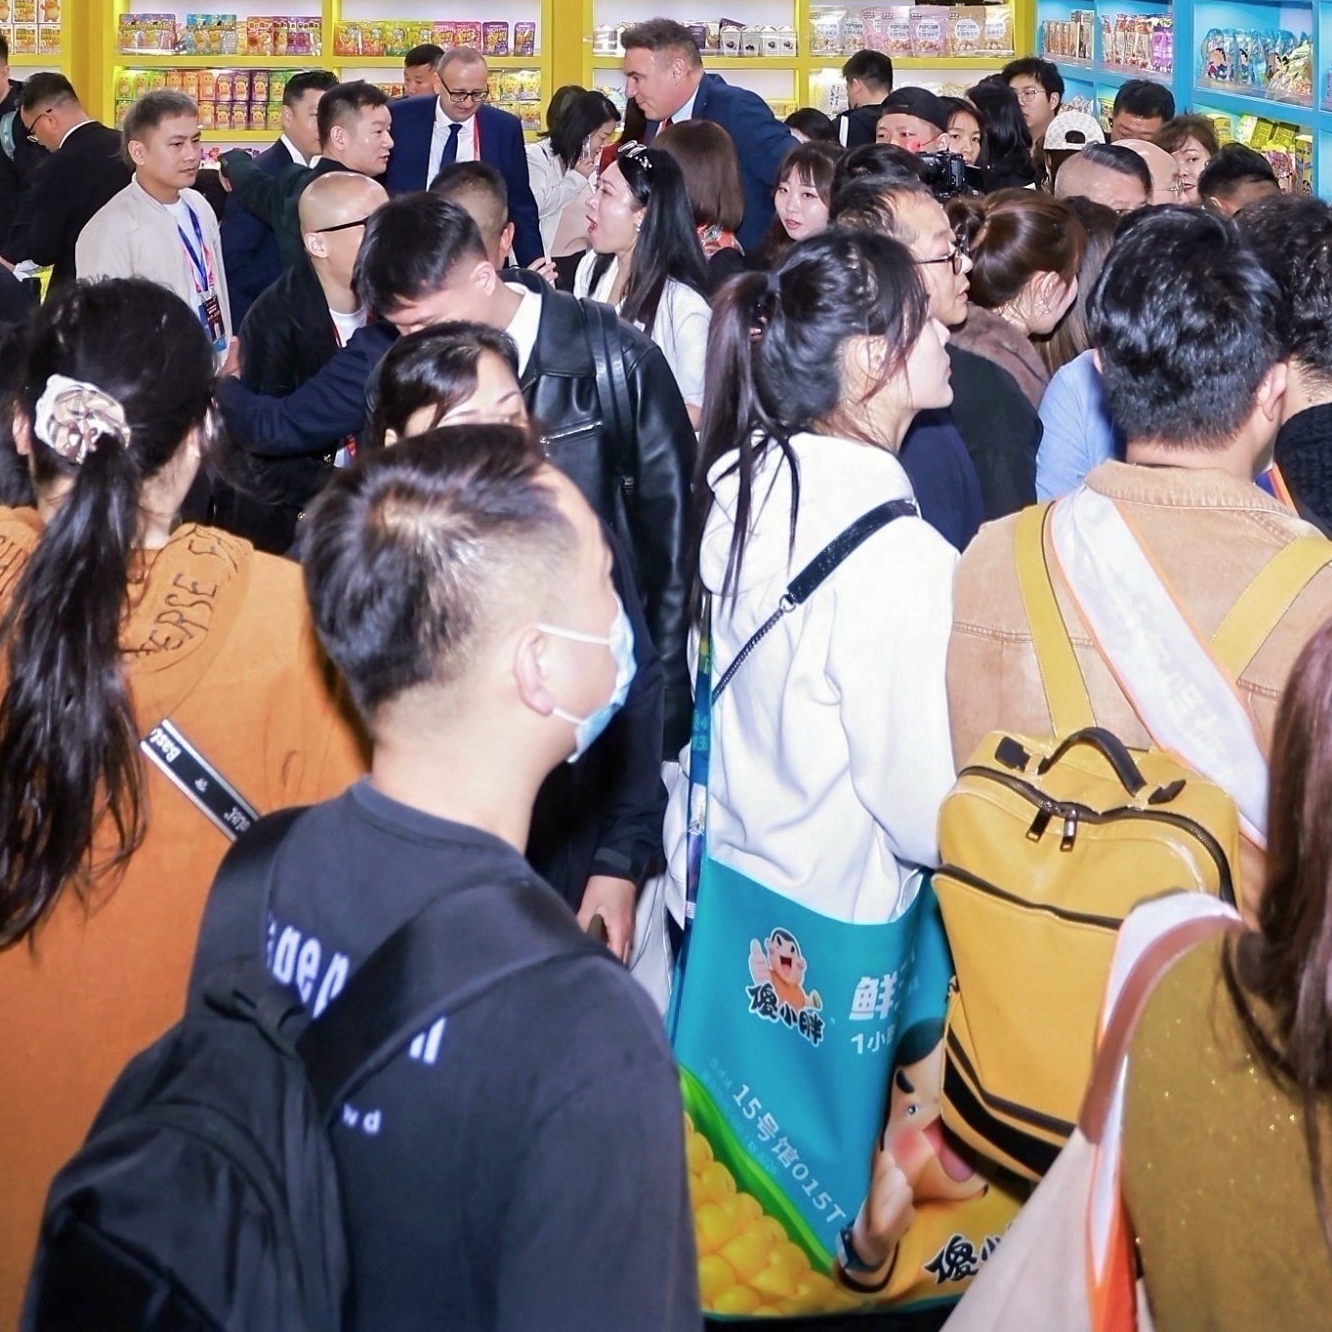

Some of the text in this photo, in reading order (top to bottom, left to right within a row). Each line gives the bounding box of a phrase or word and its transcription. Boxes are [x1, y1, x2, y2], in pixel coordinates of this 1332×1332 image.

[746, 983, 825, 1046] 傻小胖
[733, 1084, 846, 1224] 15号馆015T
